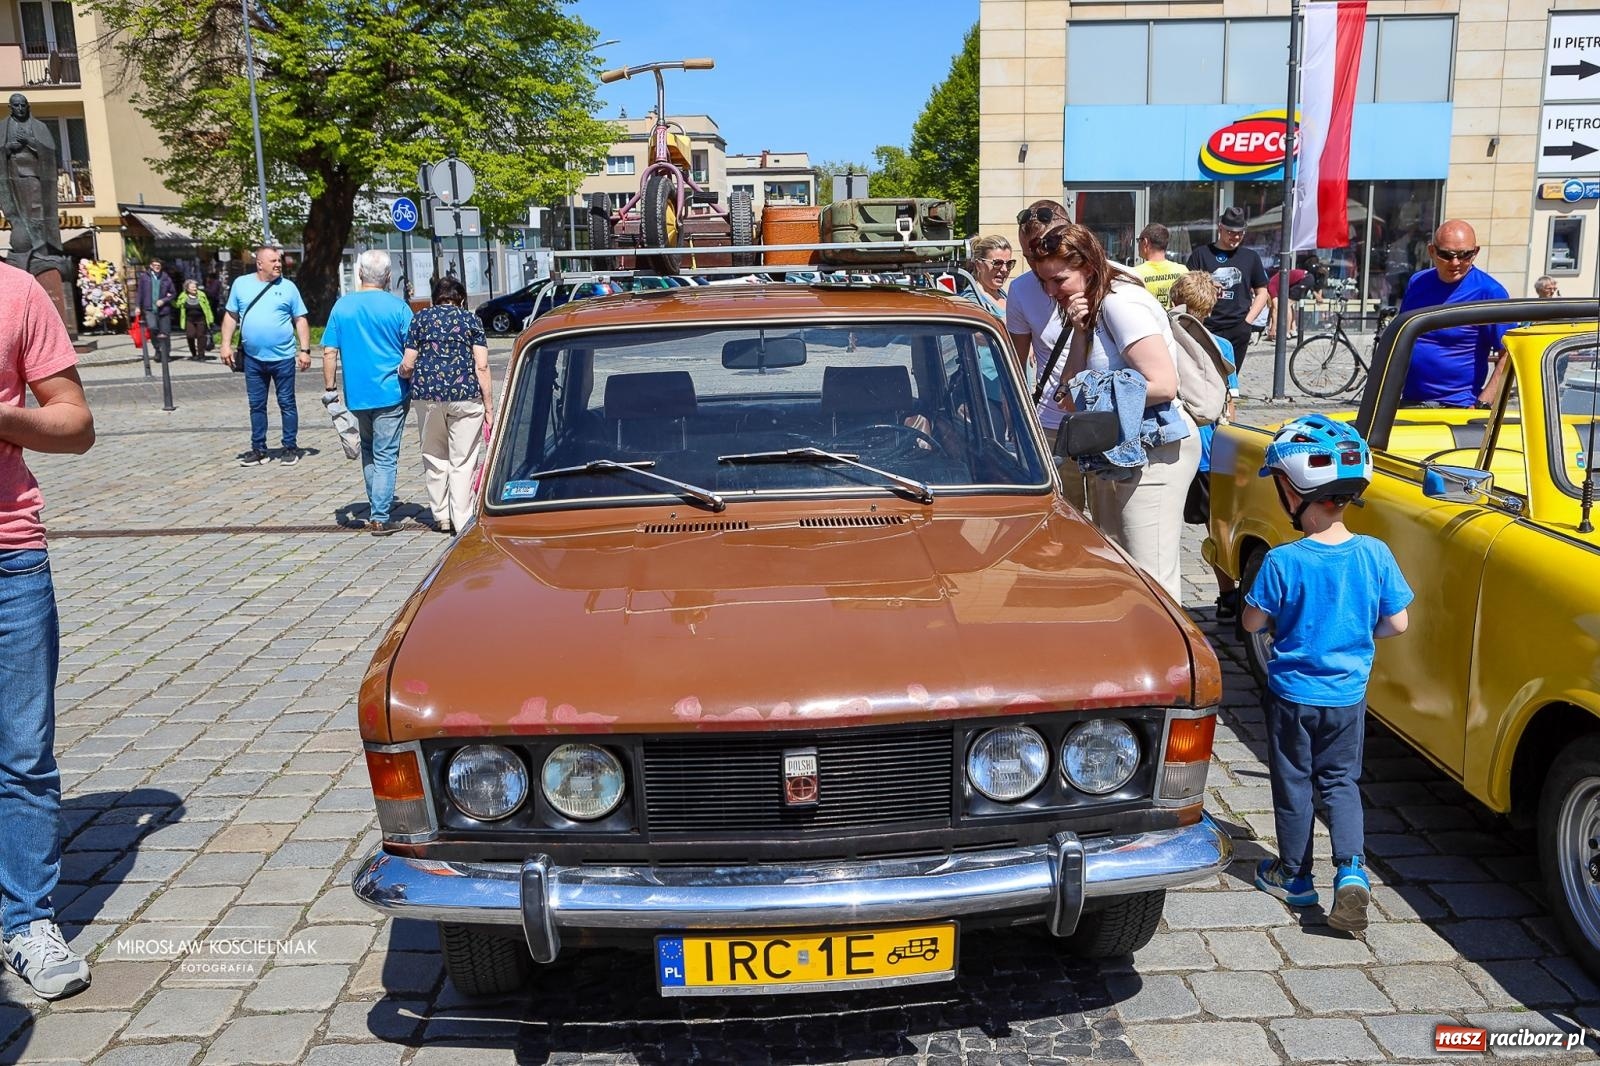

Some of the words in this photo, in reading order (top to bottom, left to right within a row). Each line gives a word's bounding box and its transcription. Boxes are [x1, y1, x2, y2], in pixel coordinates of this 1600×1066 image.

[1553, 37, 1561, 49] II
[1218, 131, 1300, 152] PEPCO
[788, 759, 814, 772] POLSKI
[704, 939, 792, 982] IRC
[818, 934, 875, 976] 1E
[664, 967, 683, 979] PL
